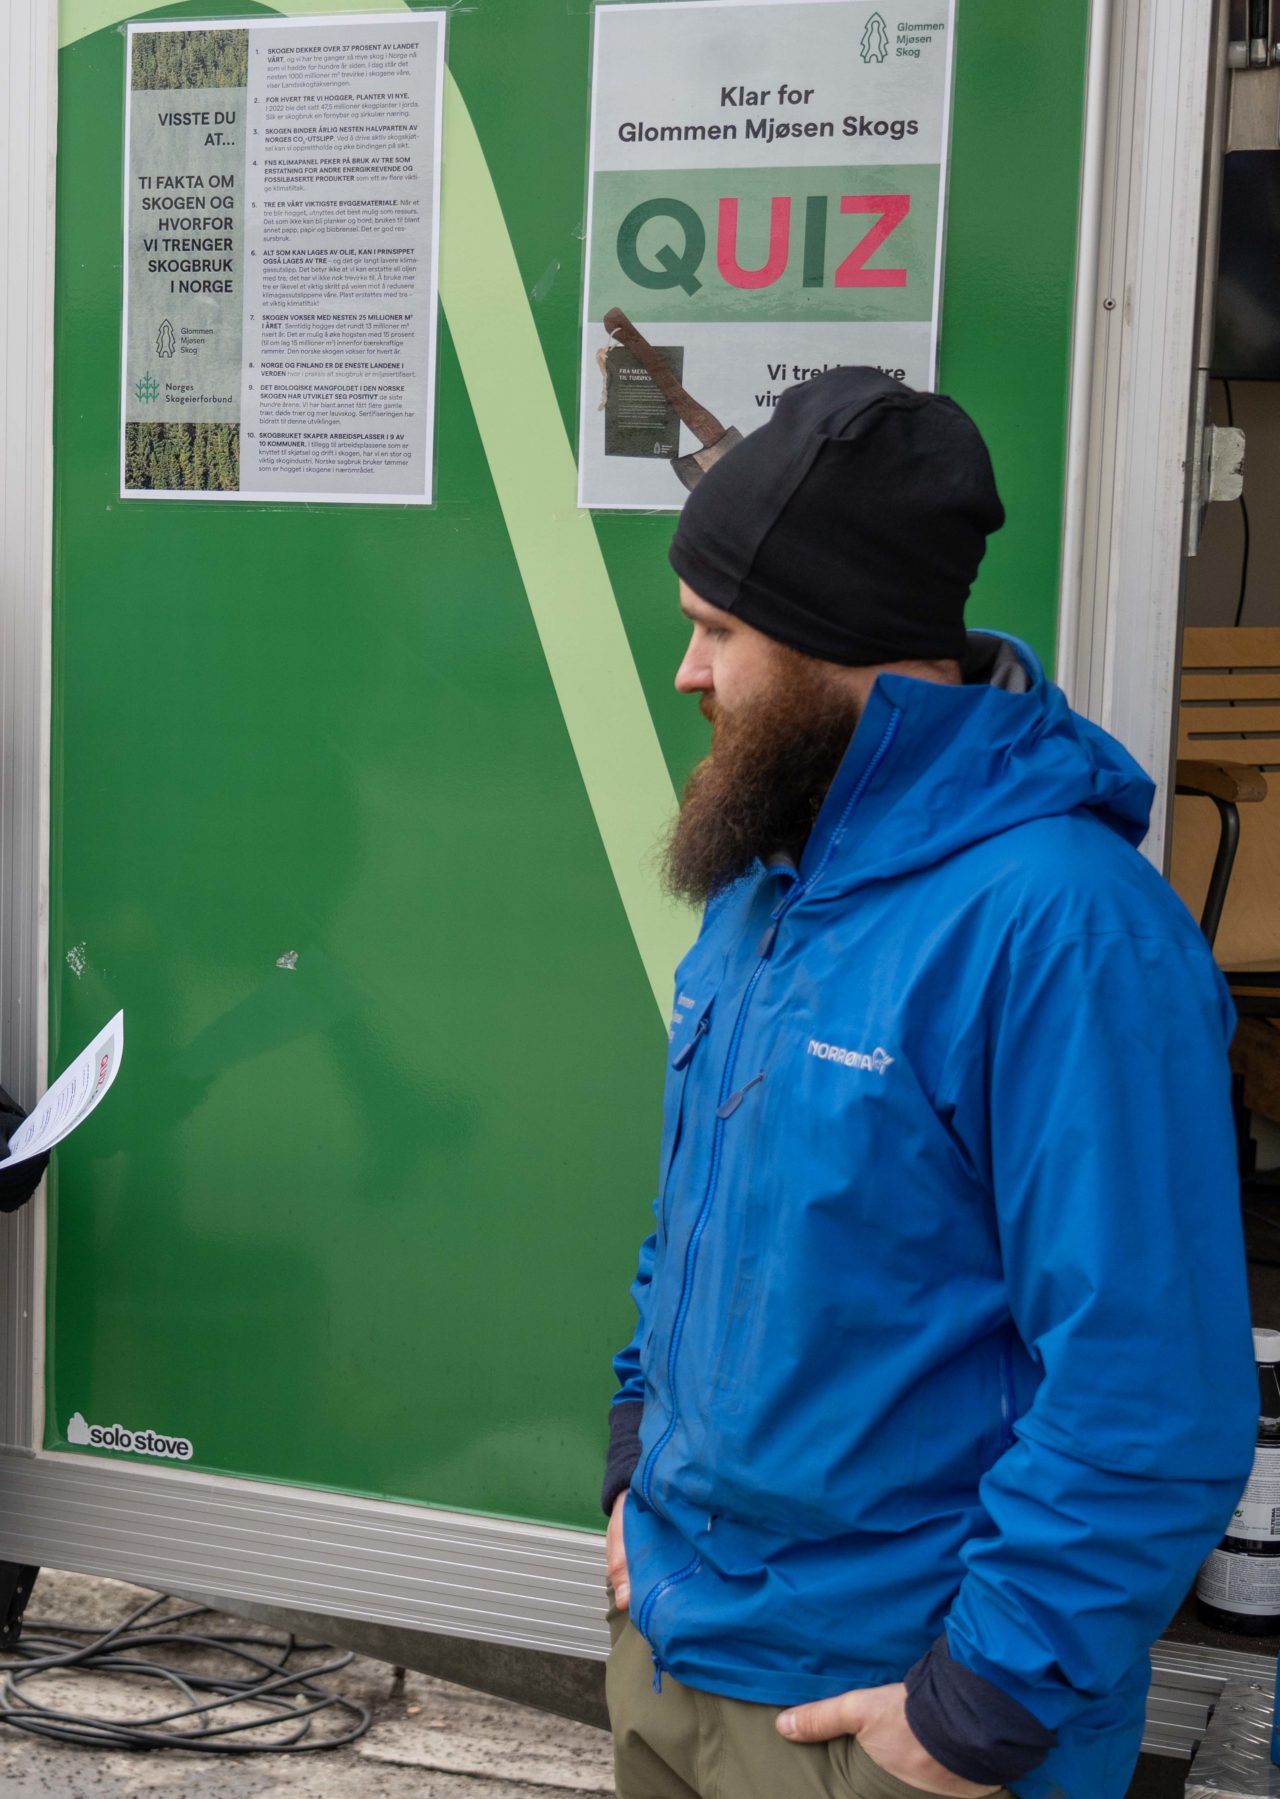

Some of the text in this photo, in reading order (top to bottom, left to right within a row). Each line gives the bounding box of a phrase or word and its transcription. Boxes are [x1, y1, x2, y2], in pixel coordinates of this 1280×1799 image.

[898, 23, 944, 31] Glommen
[897, 35, 932, 45] Mjøsen
[268, 47, 294, 55] SKOGEN
[296, 46, 322, 54] DEKKER
[351, 44, 382, 52] PROSENT
[393, 42, 419, 50] LANDET
[896, 48, 920, 58] Skog
[721, 84, 814, 106] Klar for
[157, 112, 235, 127] VISSTE DU
[318, 125, 338, 134] ÅRLIG
[365, 125, 408, 133] HALVPARTEN
[619, 116, 918, 143] Glommen Mjøsen Skogs
[204, 133, 234, 146] AT...
[342, 157, 351, 165] PÅ
[138, 175, 234, 189] TI FAKTA OM
[142, 196, 233, 210] SKOGEN OG
[287, 200, 303, 208] VÅRT
[159, 217, 233, 231] HVORFOR
[144, 238, 233, 251] VI TRENGER
[616, 195, 912, 297] QUIZ
[148, 259, 232, 272] SKOGBRUK
[263, 257, 282, 265] OGSÅ
[170, 280, 233, 294] I NORGE
[180, 327, 214, 335] Glommen
[180, 337, 206, 346] Mjøsen
[180, 346, 198, 356] Skog
[767, 363, 787, 381] Vi
[166, 383, 194, 393] Norges
[166, 395, 232, 405] Skogeierforbund
[90, 1428, 189, 1456] solo stove
